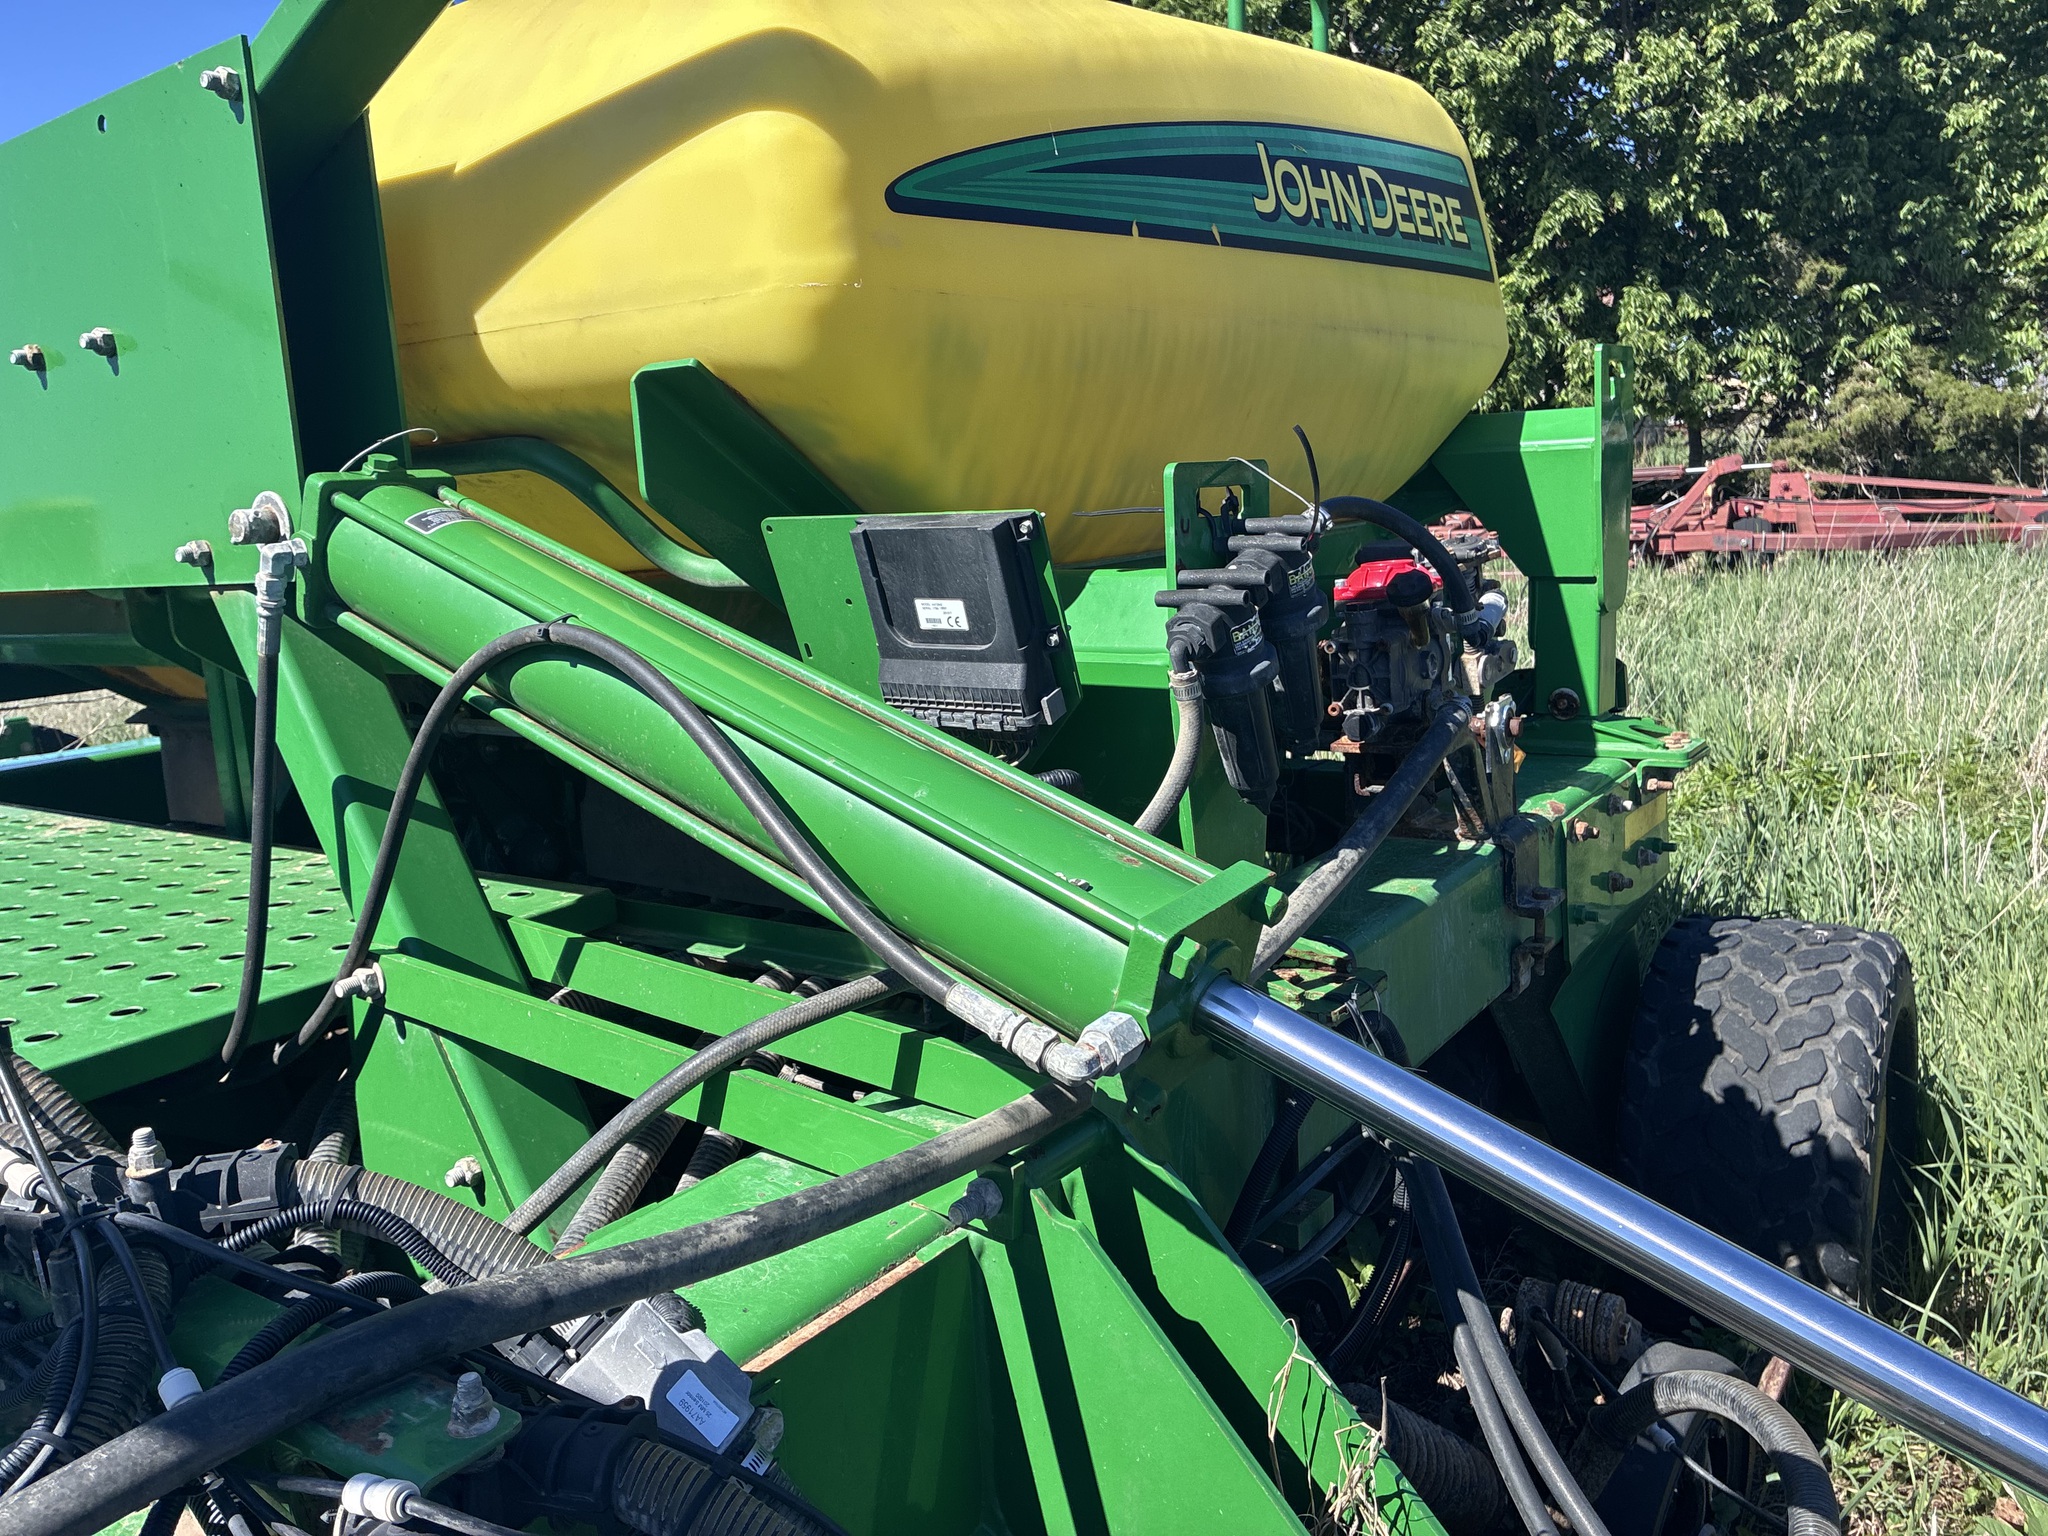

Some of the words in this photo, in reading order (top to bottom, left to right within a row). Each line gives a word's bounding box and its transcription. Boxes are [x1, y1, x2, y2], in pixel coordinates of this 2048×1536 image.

[1252, 140, 1365, 229] JOHN
[1357, 165, 1470, 246] DEERE
[678, 1398, 706, 1425] AA71959
